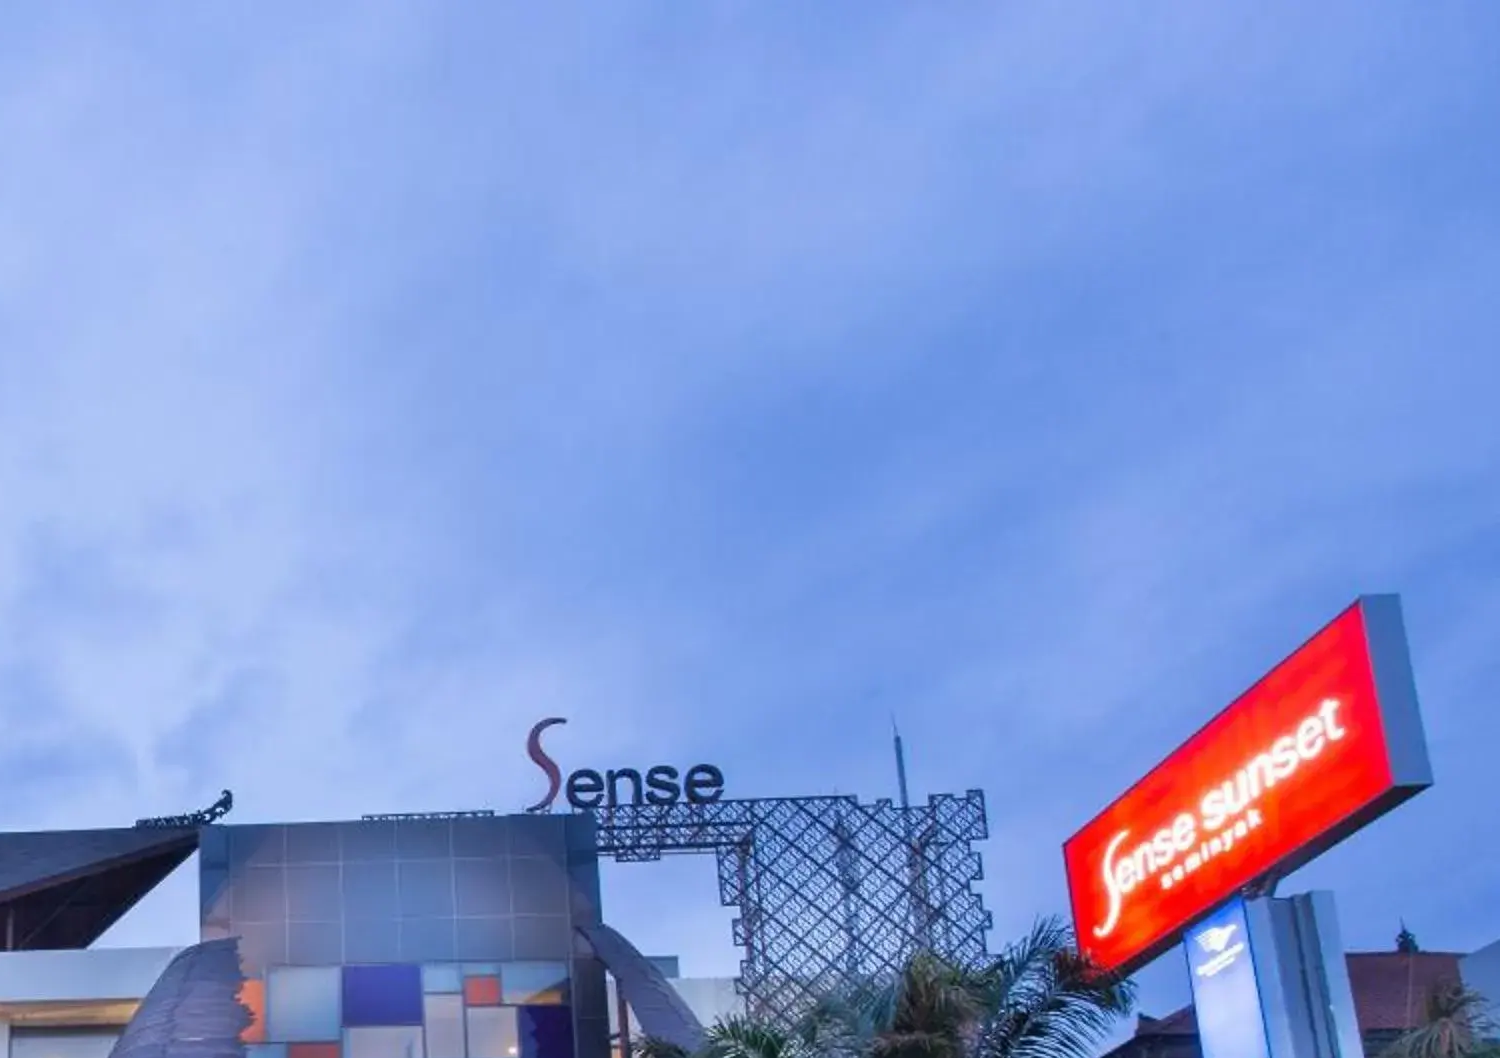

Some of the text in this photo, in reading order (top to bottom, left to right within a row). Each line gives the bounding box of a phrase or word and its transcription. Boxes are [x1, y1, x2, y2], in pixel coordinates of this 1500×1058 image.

[526, 717, 725, 813] Sense
[1093, 698, 1345, 938] Sense sunset
[1161, 809, 1262, 890] seminyak
